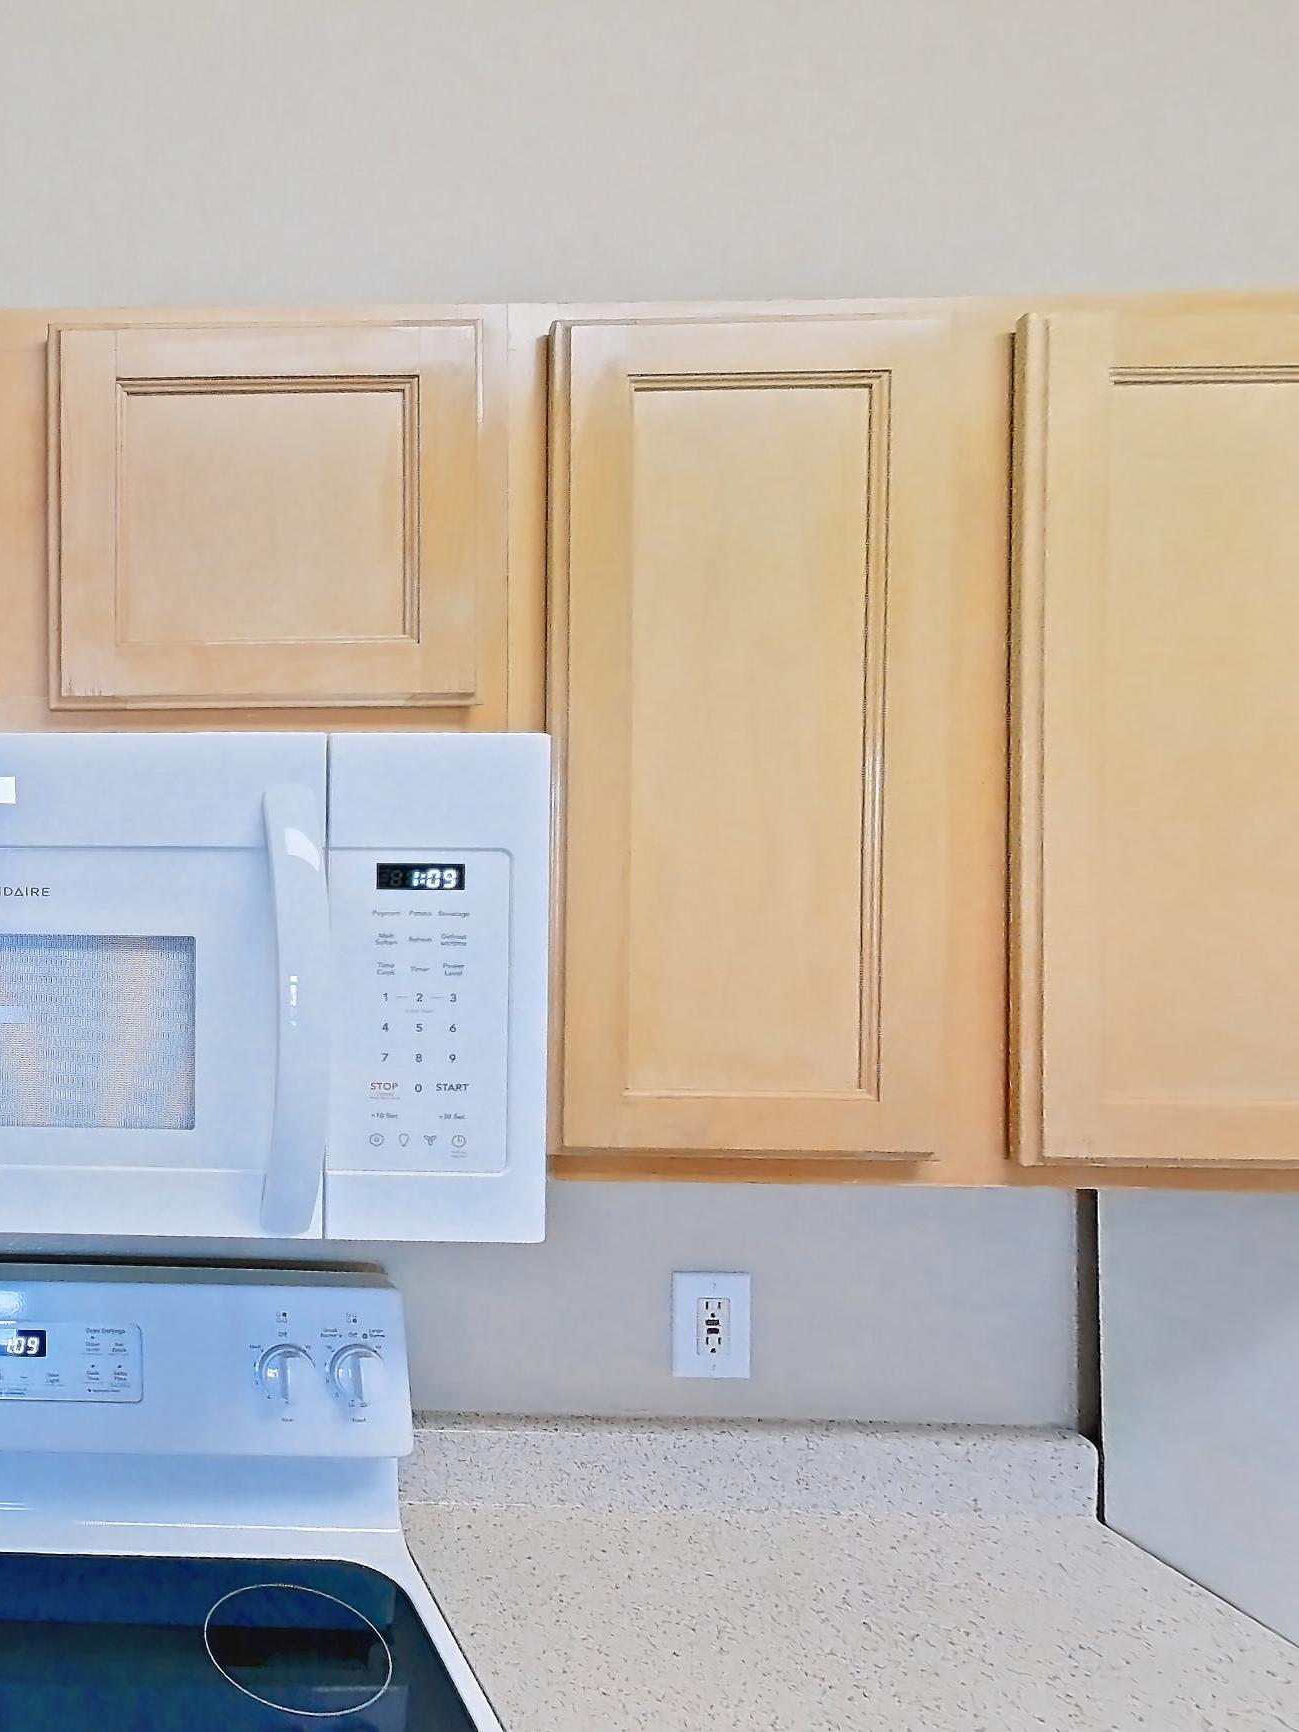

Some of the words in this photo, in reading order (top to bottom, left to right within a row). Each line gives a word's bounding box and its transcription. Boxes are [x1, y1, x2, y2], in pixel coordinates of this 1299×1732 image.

[411, 868, 458, 889] 1:09
[383, 992, 389, 1002] 1
[416, 992, 424, 1003] 2
[449, 993, 457, 1003] 3
[381, 1022, 389, 1032] 4
[415, 1023, 423, 1033] 5
[449, 1023, 457, 1033] 6
[381, 1052, 389, 1063] 7
[415, 1053, 423, 1063] 8
[448, 1053, 457, 1063] 9
[369, 1082, 399, 1091] STOP
[414, 1083, 423, 1093] 0
[435, 1083, 470, 1092] START
